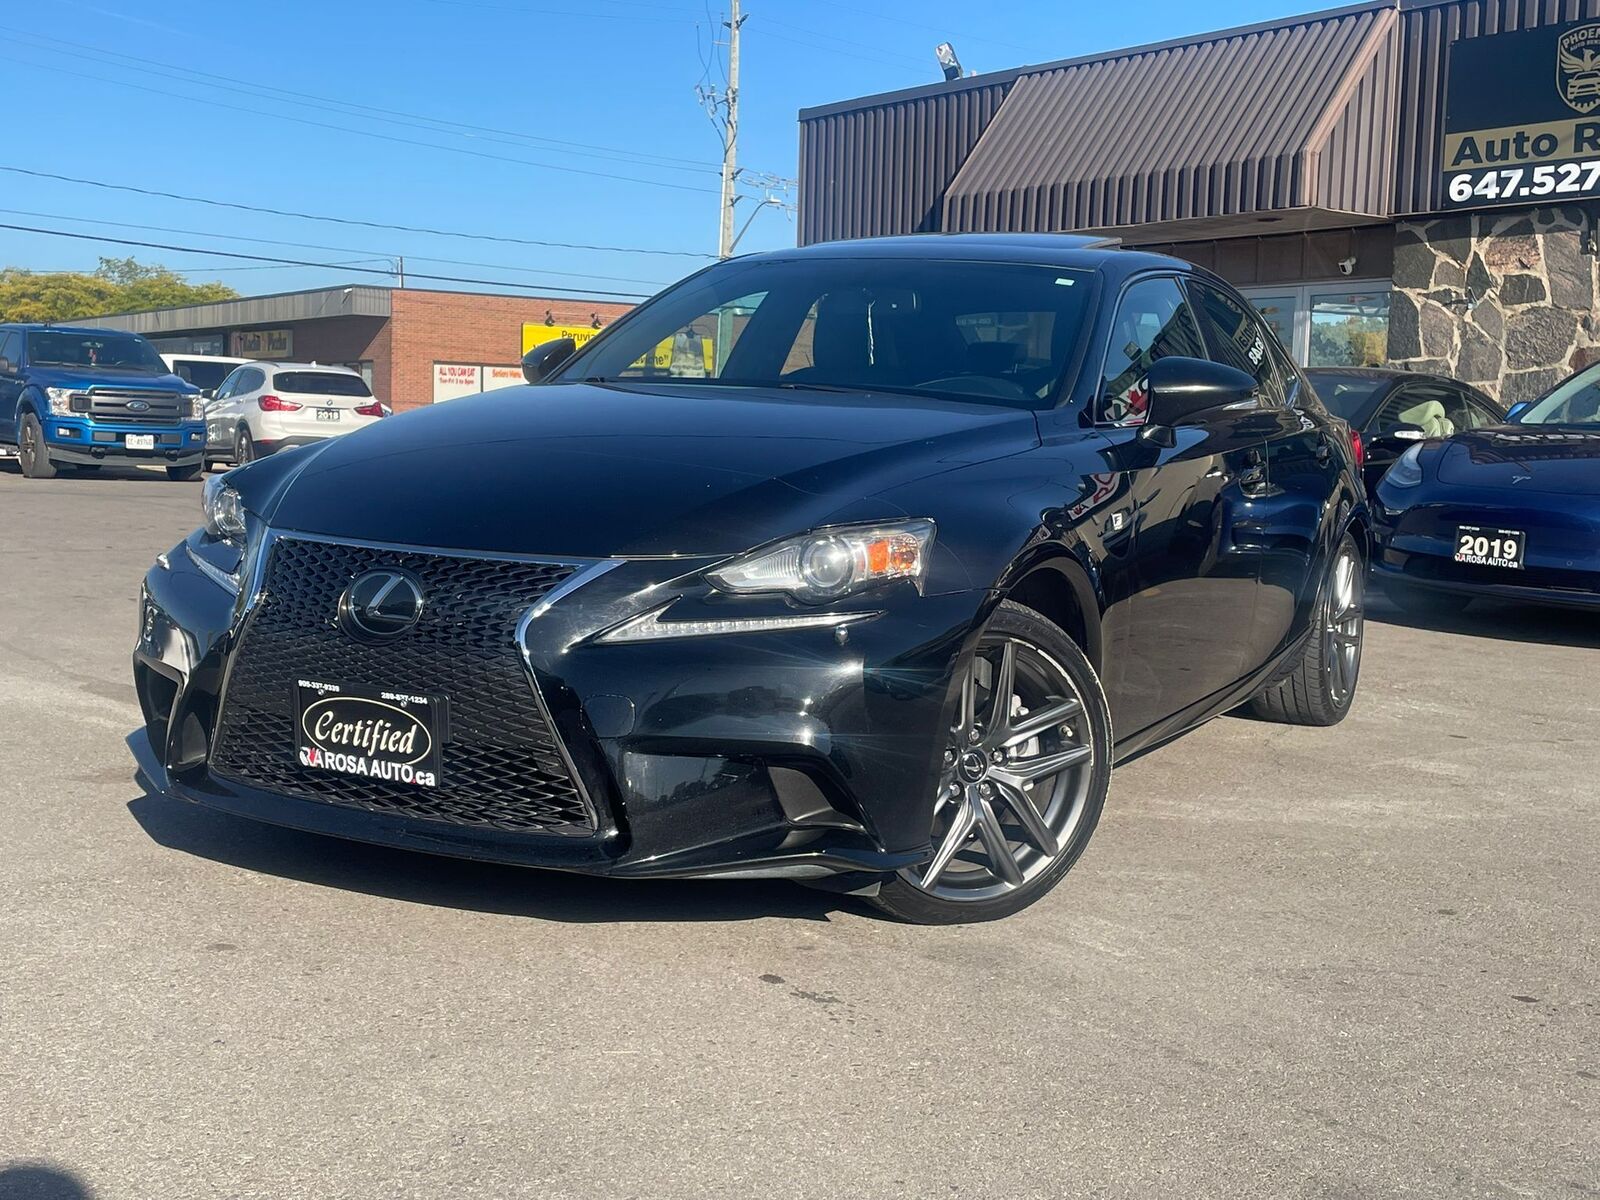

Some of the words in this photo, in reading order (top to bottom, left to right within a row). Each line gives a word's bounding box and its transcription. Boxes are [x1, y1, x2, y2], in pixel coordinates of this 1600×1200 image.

[1451, 131, 1559, 167] Auto
[317, 411, 339, 420] 2018
[1459, 535, 1517, 560] 2019
[314, 710, 418, 757] Certified
